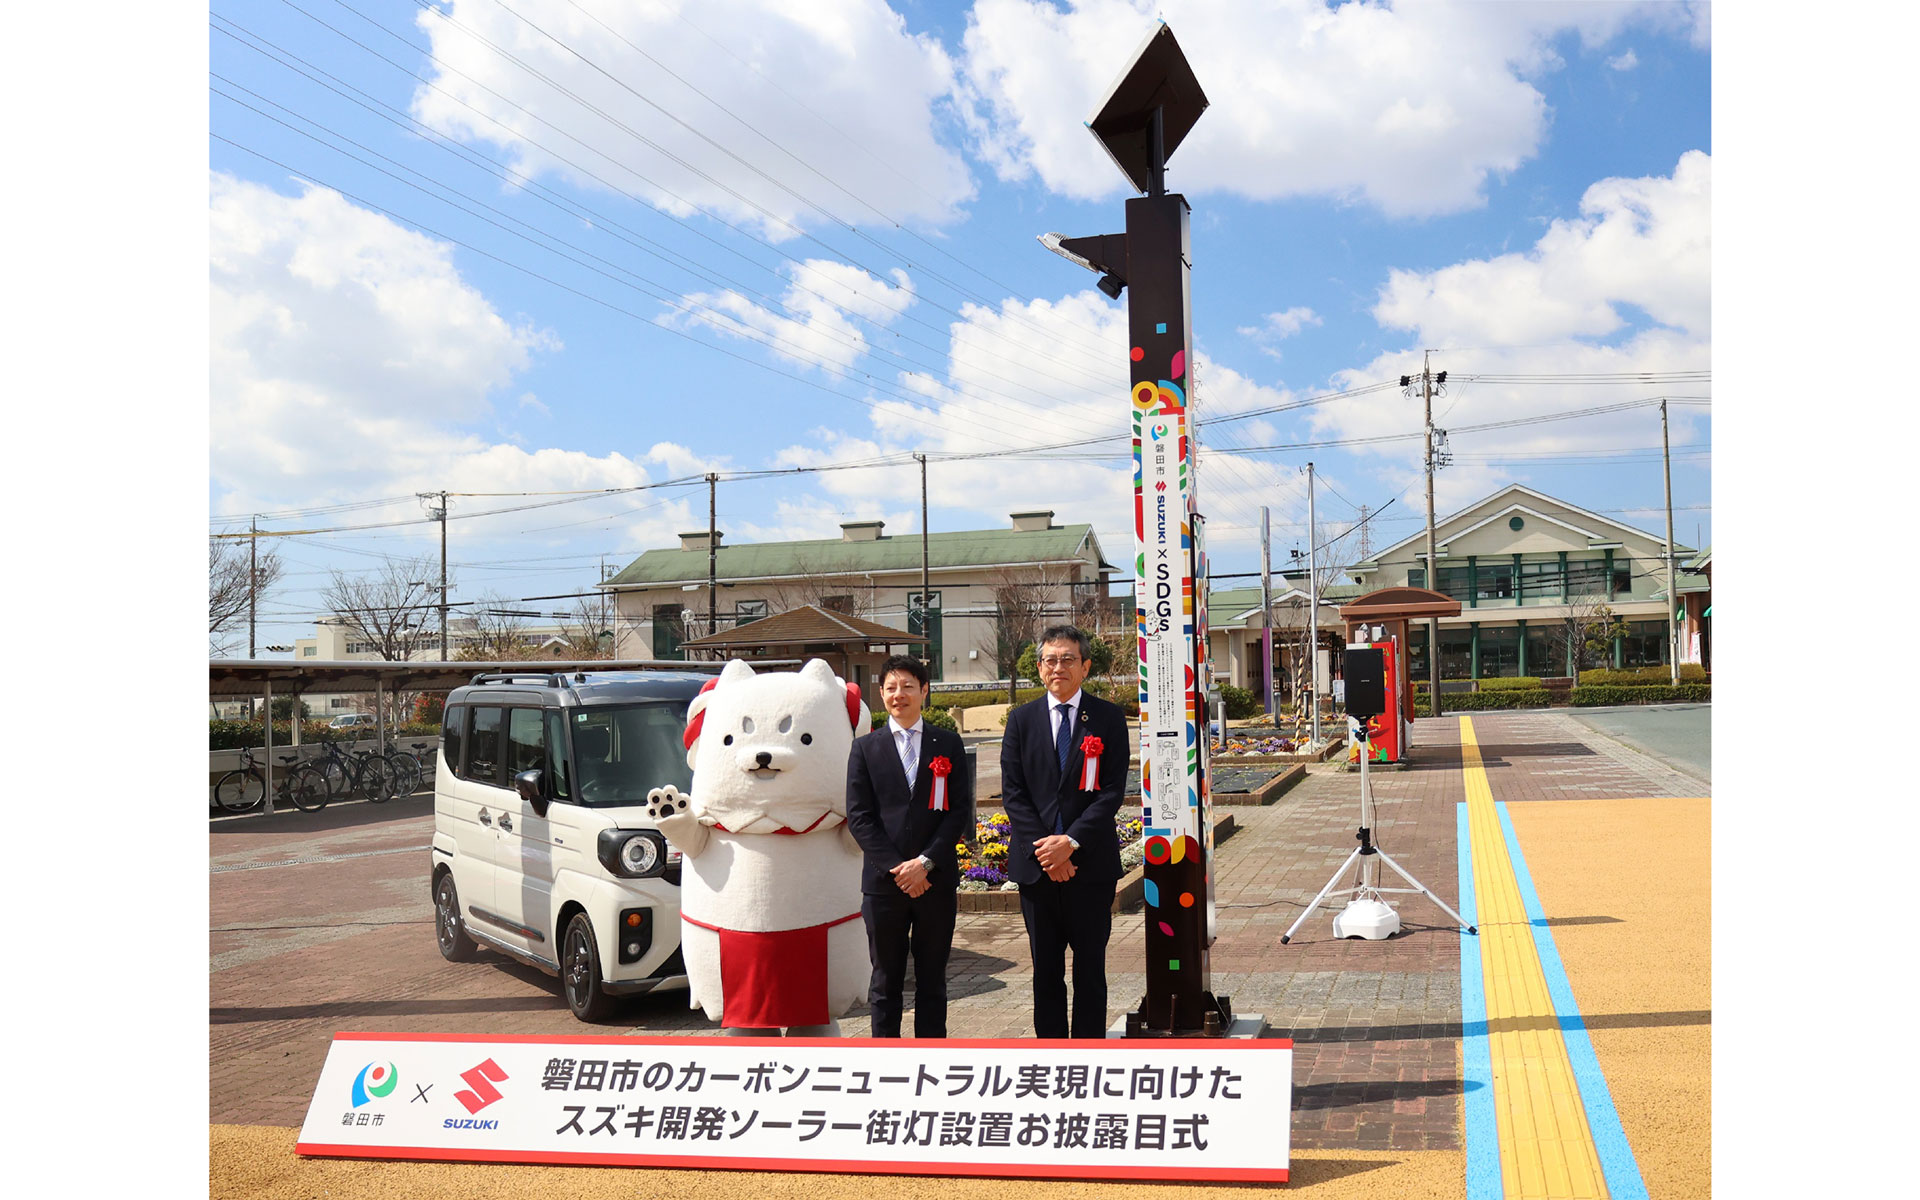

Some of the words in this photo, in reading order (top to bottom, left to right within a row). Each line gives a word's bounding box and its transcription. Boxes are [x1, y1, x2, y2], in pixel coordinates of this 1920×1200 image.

[1156, 494, 1167, 544] SUZUKI
[1156, 563, 1172, 632] SDGs
[540, 1057, 1242, 1100] 磐田市のカーボンニュートラル実現に向けた
[341, 1112, 386, 1127] 磐田市
[442, 1118, 499, 1130] SUZUKI
[555, 1104, 1210, 1151] スズキ開発ソーラー街灯設置お披露目式
